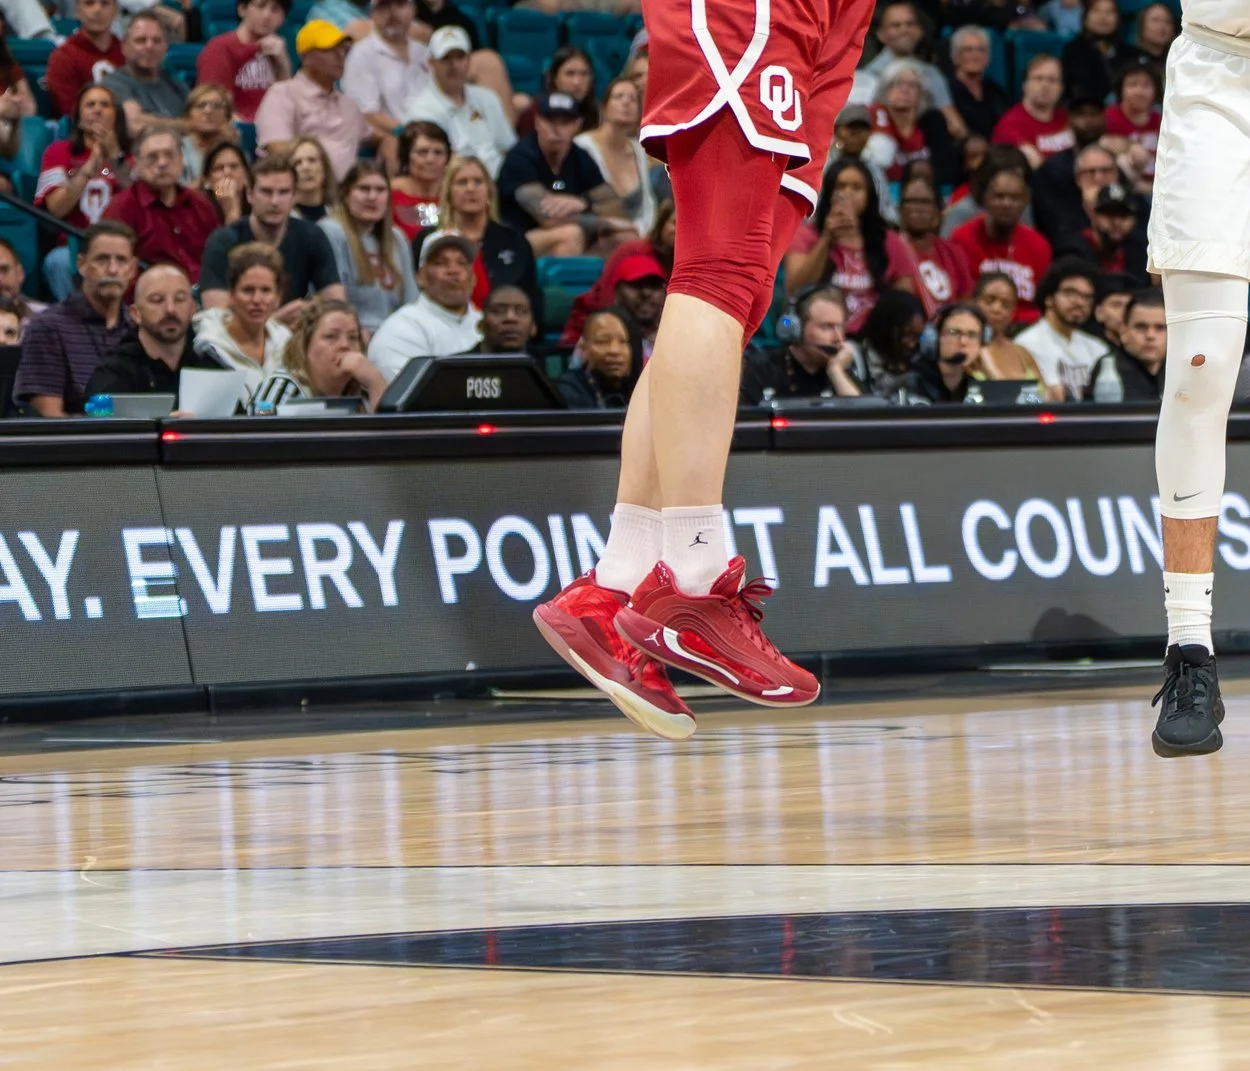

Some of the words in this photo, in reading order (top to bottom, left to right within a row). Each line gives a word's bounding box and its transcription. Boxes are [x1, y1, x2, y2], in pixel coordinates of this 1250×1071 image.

[759, 64, 803, 132] OU
[466, 377, 501, 399] POSS
[122, 520, 405, 620] EVERY
[427, 513, 614, 604] POIN
[813, 504, 953, 588] ALL
